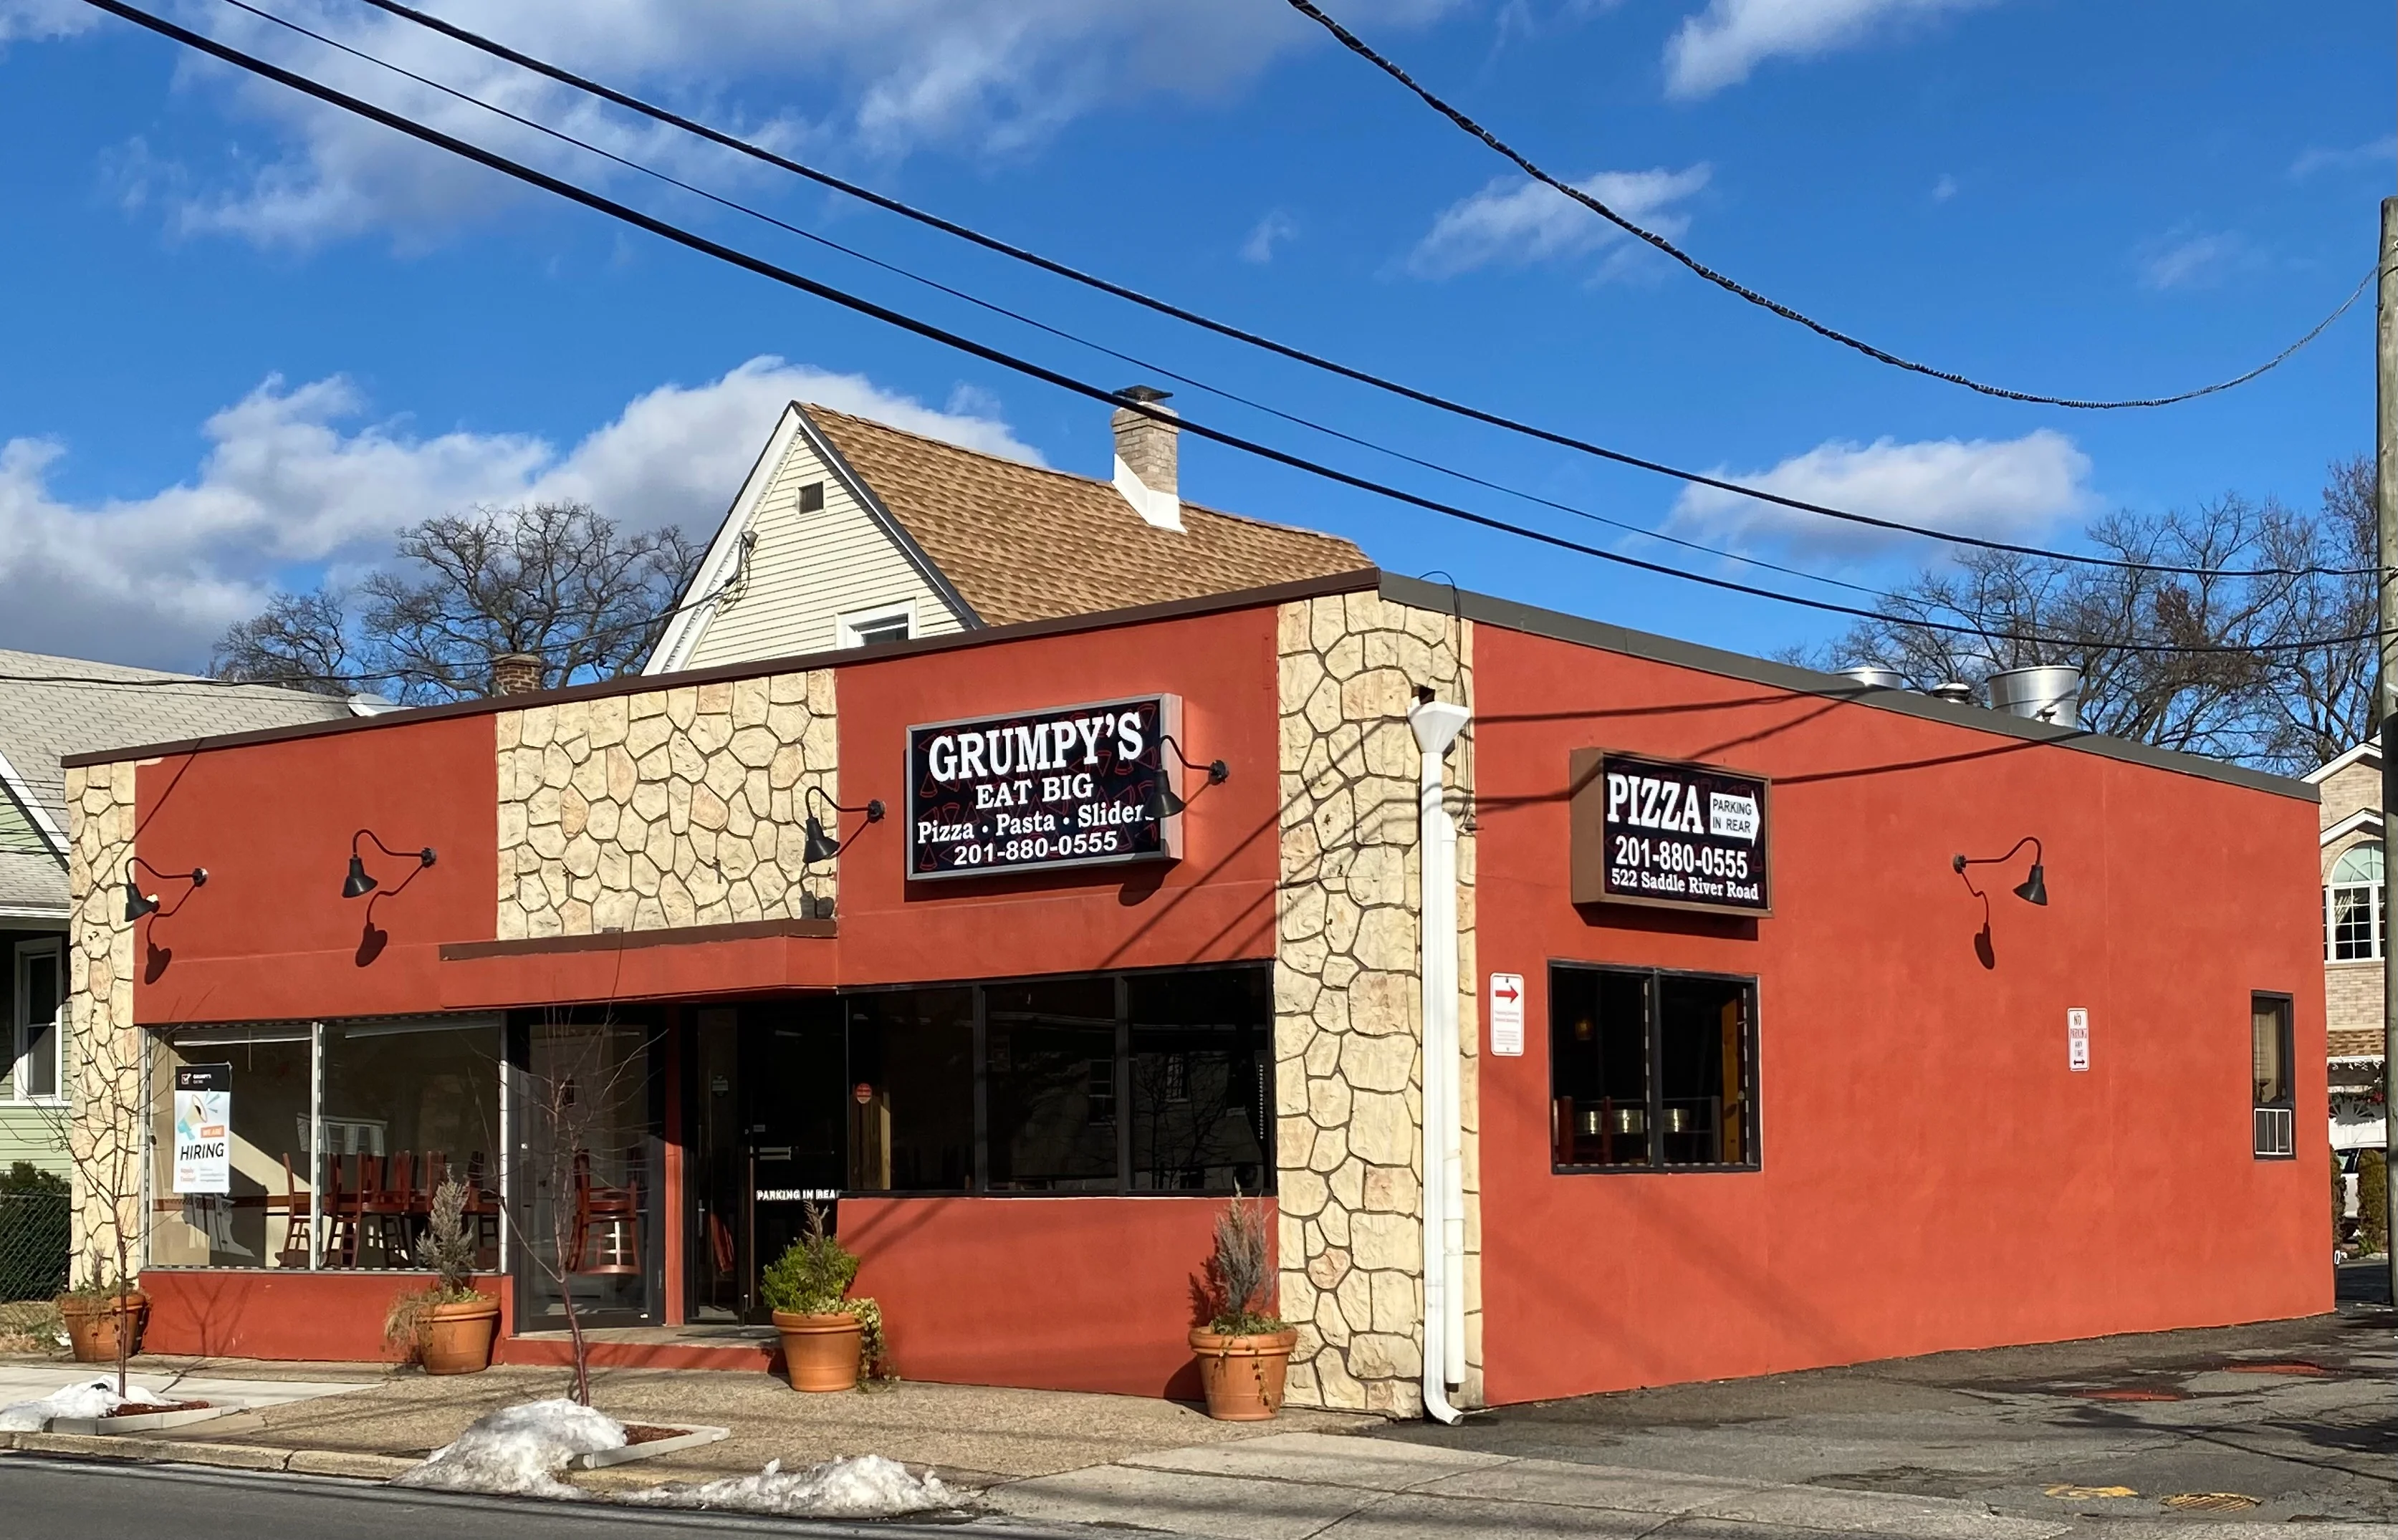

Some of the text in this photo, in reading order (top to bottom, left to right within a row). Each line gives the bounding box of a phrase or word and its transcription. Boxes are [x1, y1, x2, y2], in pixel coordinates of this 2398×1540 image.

[929, 711, 1143, 782] GRUMPY'S
[976, 773, 1093, 809] EAT BIG
[1607, 772, 1704, 834] PIZZA
[1713, 798, 1752, 816] PARKING
[918, 800, 1154, 844] Pizza Pasta Slider
[1713, 817, 1751, 834] IN REAR
[954, 831, 1118, 865] 201-880-0555
[1615, 835, 1748, 880] 201-880-0555
[1611, 868, 1759, 900] 522 Saddle River Road
[180, 1142, 224, 1161] HIRING
[757, 1189, 801, 1200] PARKING
[802, 1189, 813, 1200] IN
